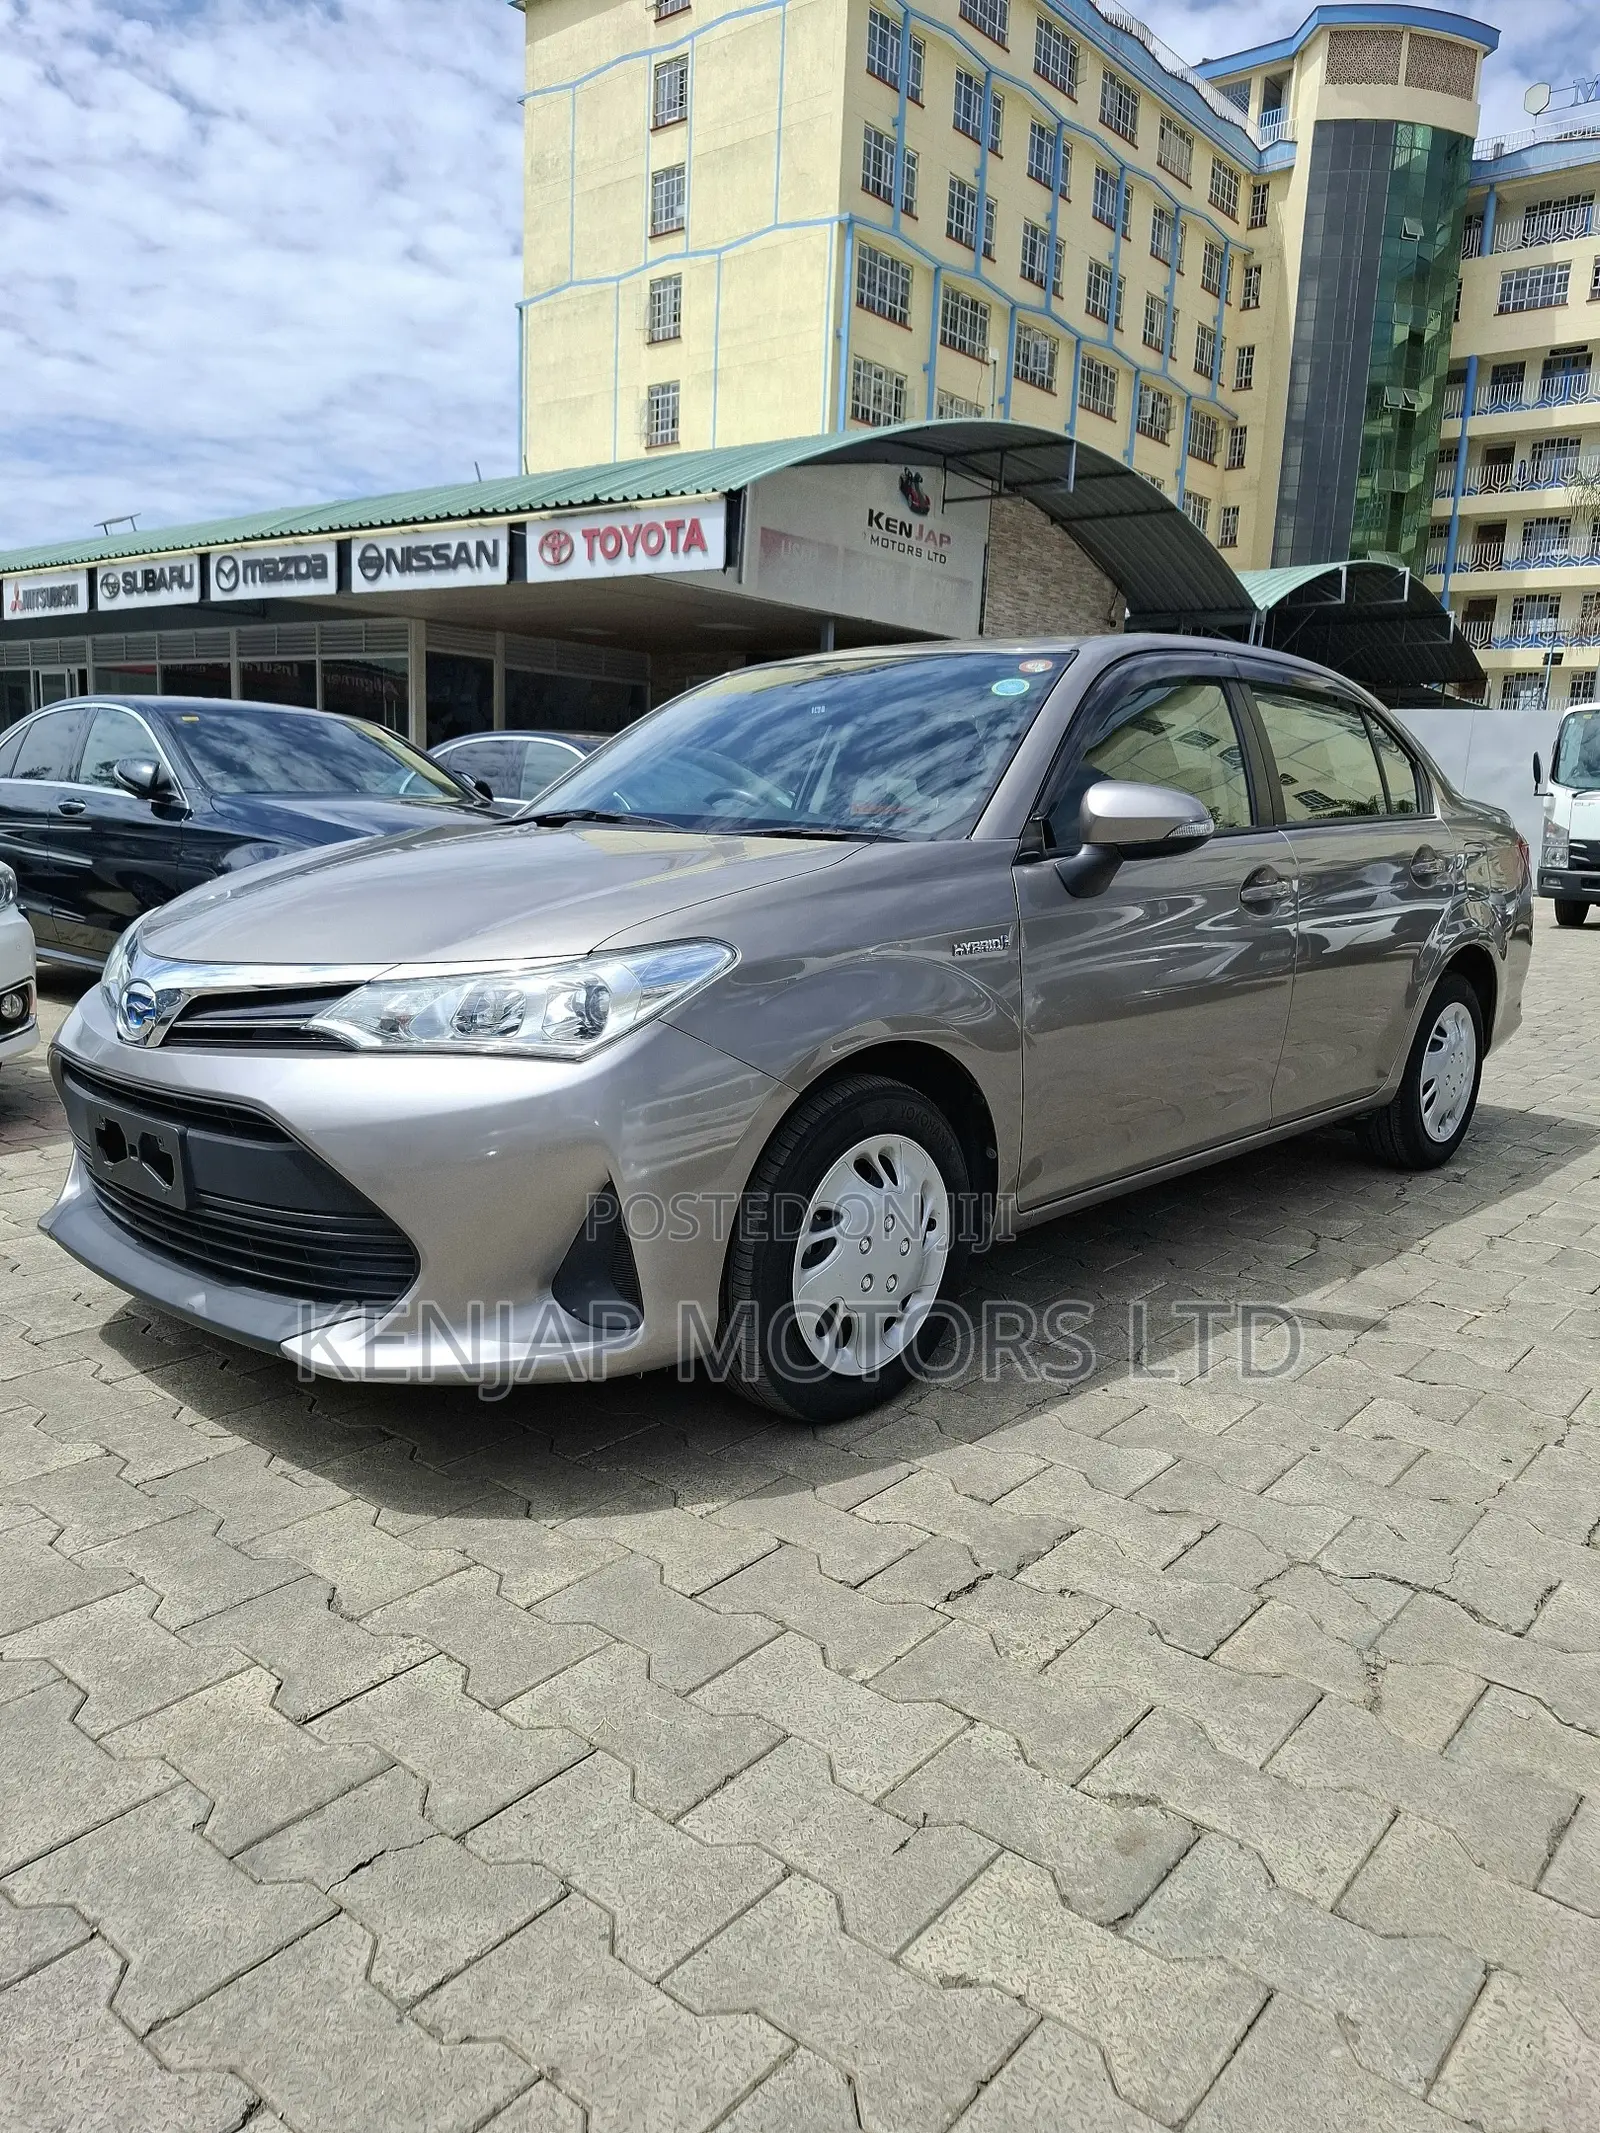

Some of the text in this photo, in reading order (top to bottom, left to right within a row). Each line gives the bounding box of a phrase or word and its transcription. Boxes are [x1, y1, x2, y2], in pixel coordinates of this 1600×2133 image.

[582, 517, 708, 561] TOYOTA
[868, 508, 952, 548] KENJAP
[385, 538, 498, 575] NISSAN
[870, 534, 947, 565] MOTORS LTD
[121, 563, 194, 595] SUBARU
[952, 938, 1001, 957] HYBRID
